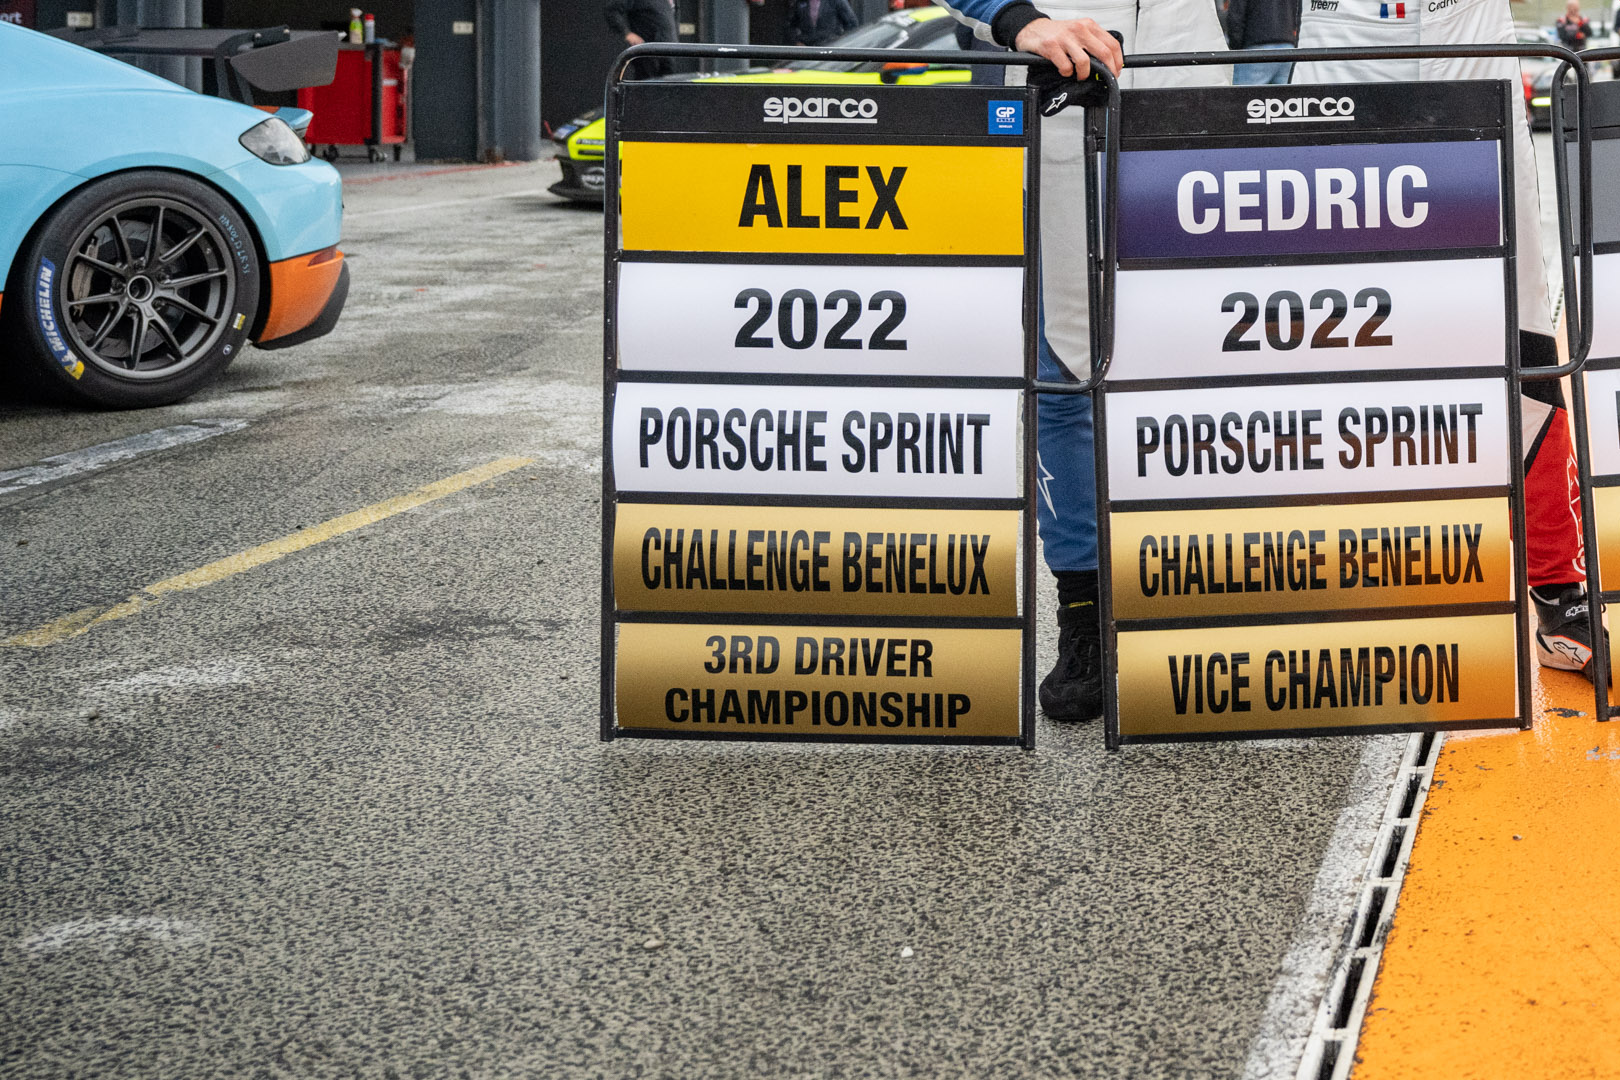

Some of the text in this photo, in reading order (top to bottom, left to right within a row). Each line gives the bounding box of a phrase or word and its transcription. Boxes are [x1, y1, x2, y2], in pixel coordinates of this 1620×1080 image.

[763, 96, 879, 124] sparco
[996, 106, 1016, 118] GP
[1246, 96, 1355, 125] sparco
[738, 164, 908, 230] ALEX
[1177, 165, 1429, 234] CEDRIC
[38, 266, 66, 352] MICHELIN
[735, 289, 908, 351] 2022
[1221, 287, 1393, 352] 2022
[639, 407, 991, 475] PORSCHE SPRINT
[1137, 404, 1483, 477] PORSCHE SPRINT
[641, 526, 991, 595] CHALLENGE BENELUX
[1139, 523, 1484, 598] CHALLENGE BENELUX
[704, 635, 934, 678] 3RD DRIVER
[1168, 643, 1461, 716] VICE CHAMPION
[664, 687, 971, 729] CHAMPIONSHIP
